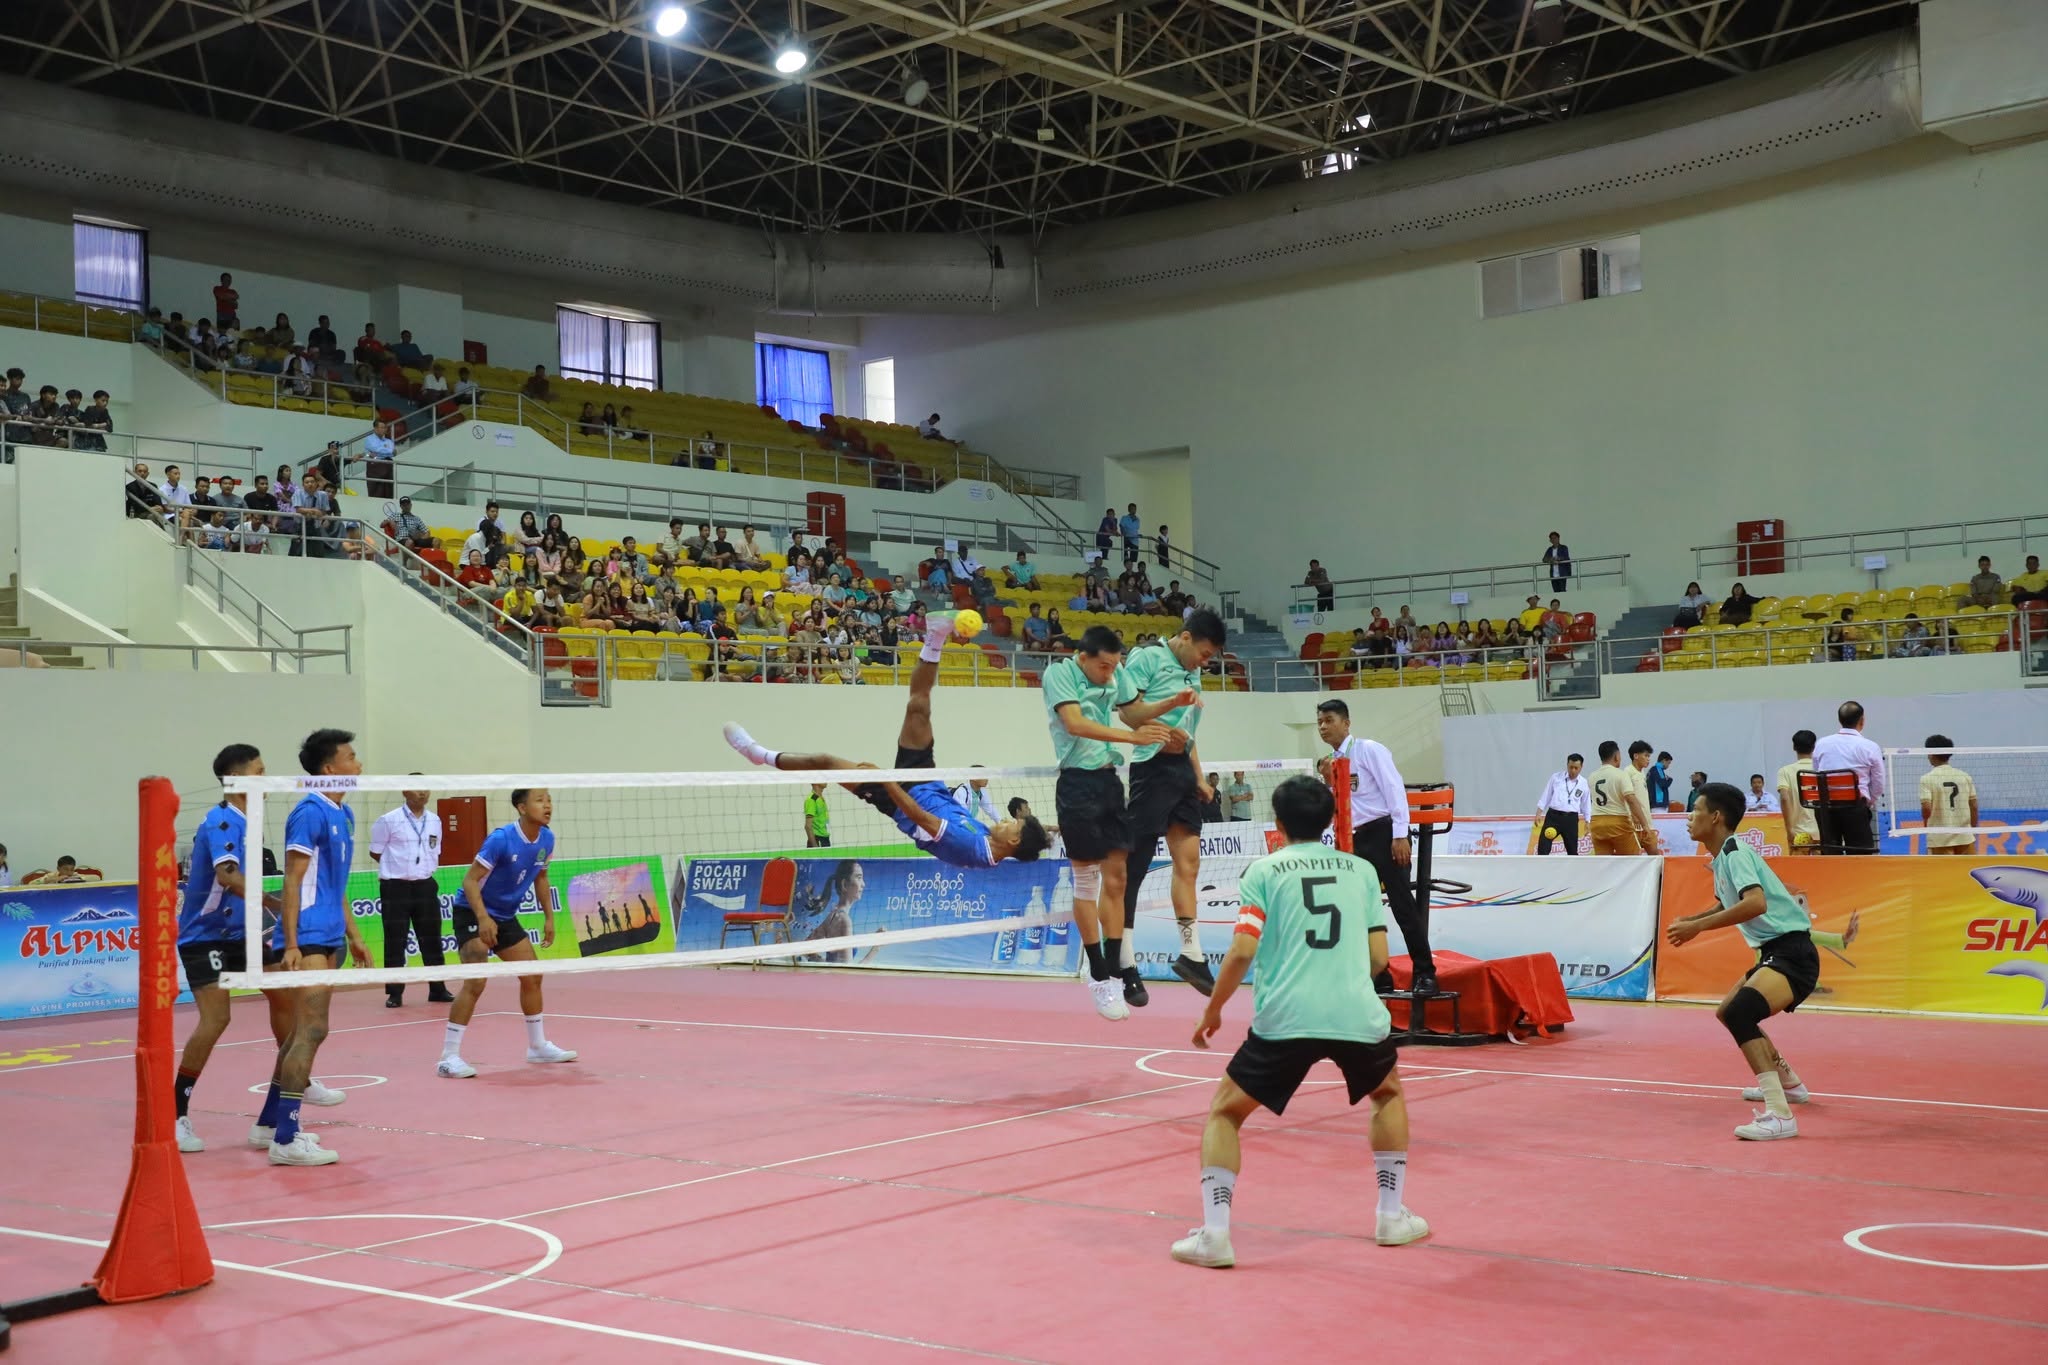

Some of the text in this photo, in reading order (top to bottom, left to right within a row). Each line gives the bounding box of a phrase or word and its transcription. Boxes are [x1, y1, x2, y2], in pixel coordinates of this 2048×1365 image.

[305, 778, 357, 788] MARATHON
[1594, 779, 1608, 806] 5
[1943, 782, 1959, 808] 7
[1199, 836, 1242, 857] RATION
[694, 864, 747, 878] POCARI
[1272, 857, 1355, 876] MONPIFER
[692, 877, 742, 890] SWEAT
[886, 896, 909, 911] ION
[1301, 876, 1341, 949] 5
[20, 925, 140, 958] ALPINE
[156, 877, 171, 1009] MARATHON
[1963, 918, 2048, 951] SHA
[38, 955, 130, 969] Purified Drinking Water
[209, 950, 223, 971] 6
[30, 1003, 63, 1013] ALPINE
[66, 1000, 112, 1009] PROMISES
